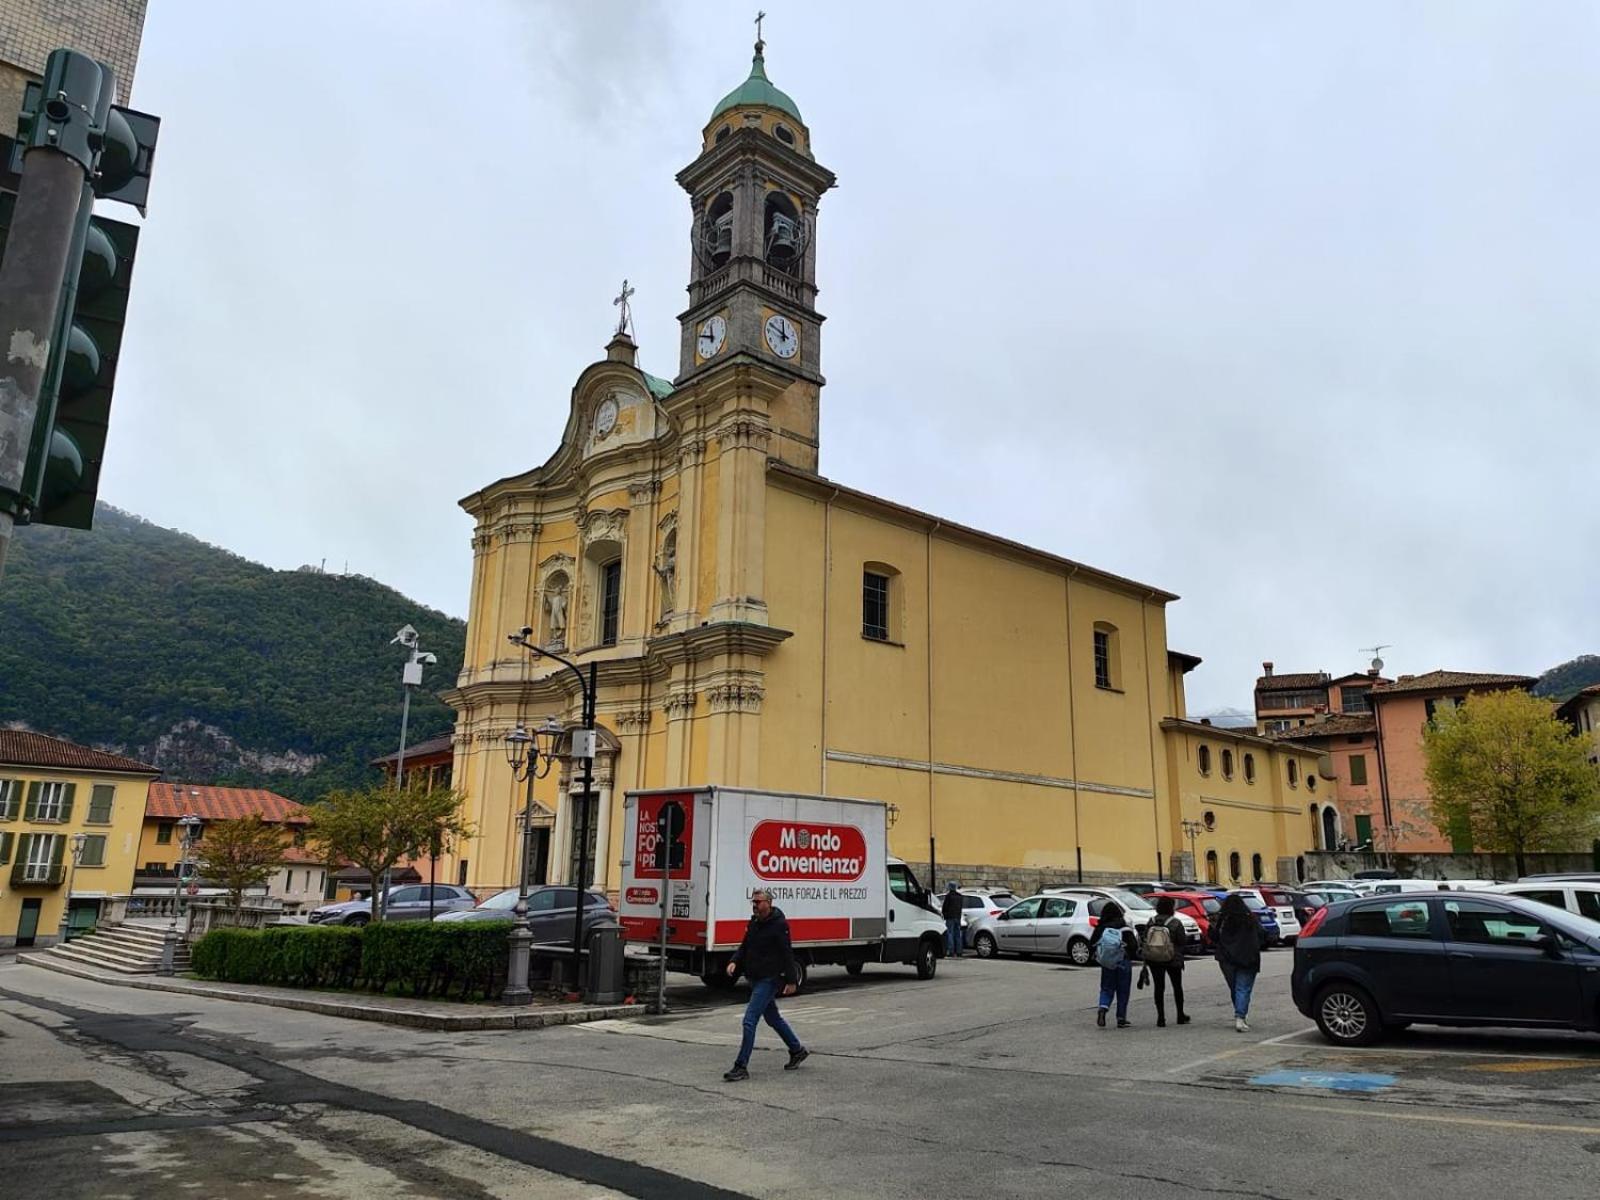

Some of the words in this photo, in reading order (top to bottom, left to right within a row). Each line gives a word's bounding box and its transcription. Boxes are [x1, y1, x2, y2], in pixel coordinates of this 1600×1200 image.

[640, 810, 649, 820] LA
[758, 850, 859, 874] Convenienza
[763, 886, 794, 900] OSTRA
[796, 886, 821, 900] FORZA
[830, 887, 838, 900] IL
[839, 887, 867, 900] PREZZO
